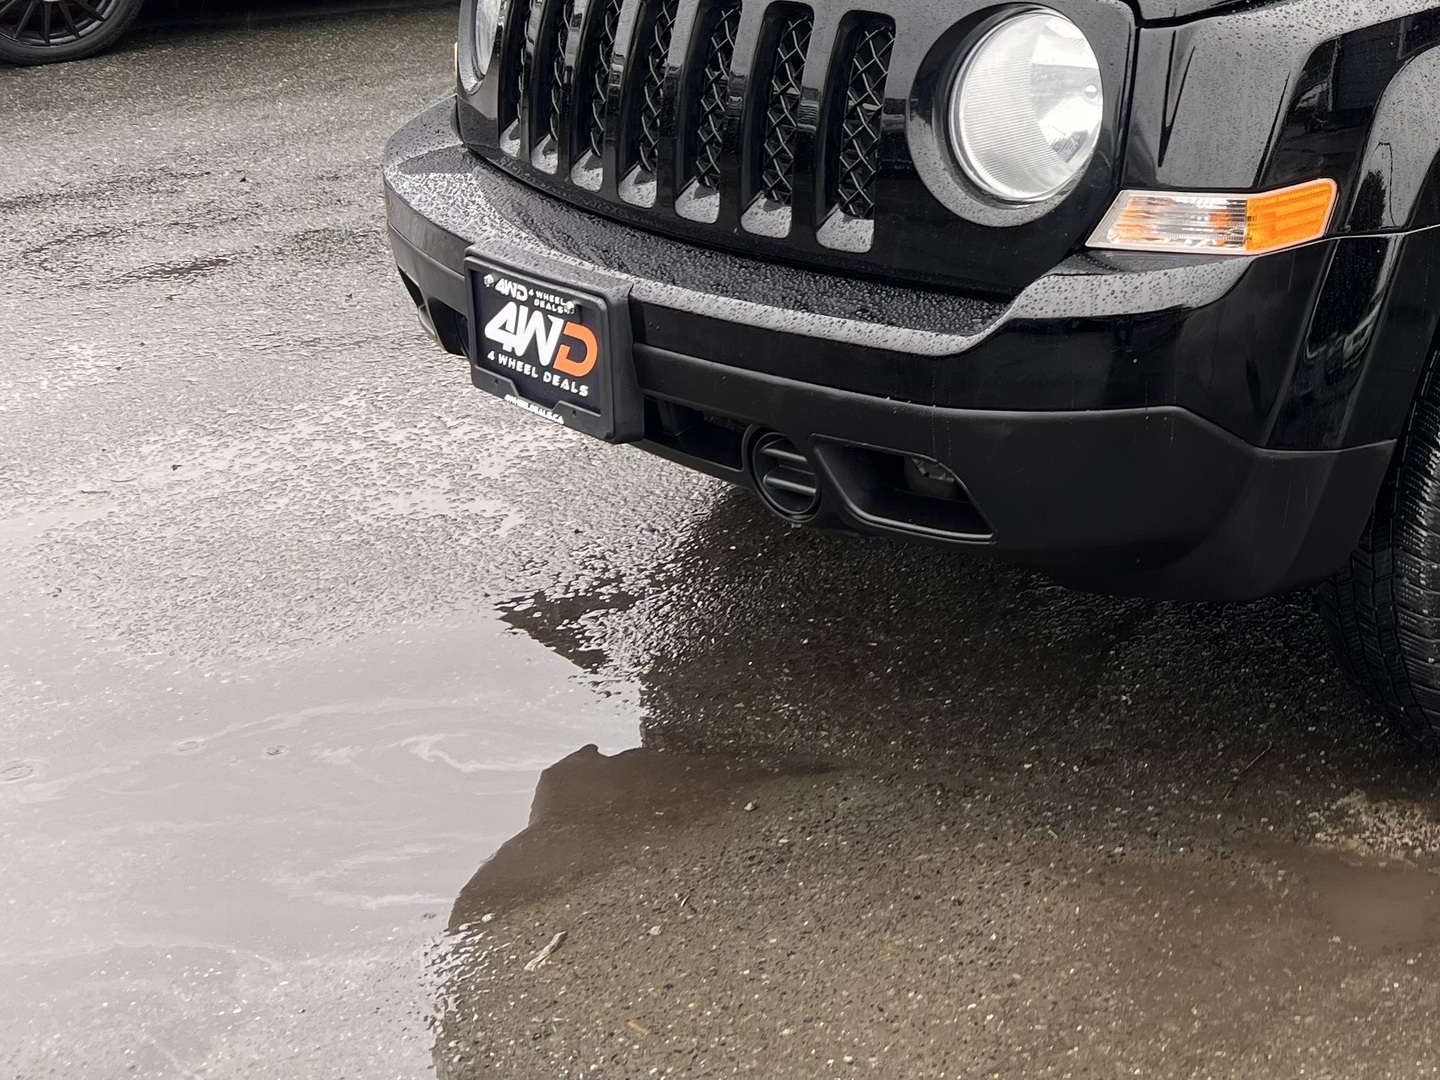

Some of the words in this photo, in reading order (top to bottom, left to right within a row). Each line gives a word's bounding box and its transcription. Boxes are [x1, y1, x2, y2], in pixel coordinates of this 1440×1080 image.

[534, 298, 564, 314] DEALS
[536, 290, 567, 306] WHEEL
[484, 301, 598, 377] 4WD
[487, 350, 496, 361] 4
[498, 353, 539, 378] WHEEL
[543, 373, 589, 397] DEALS
